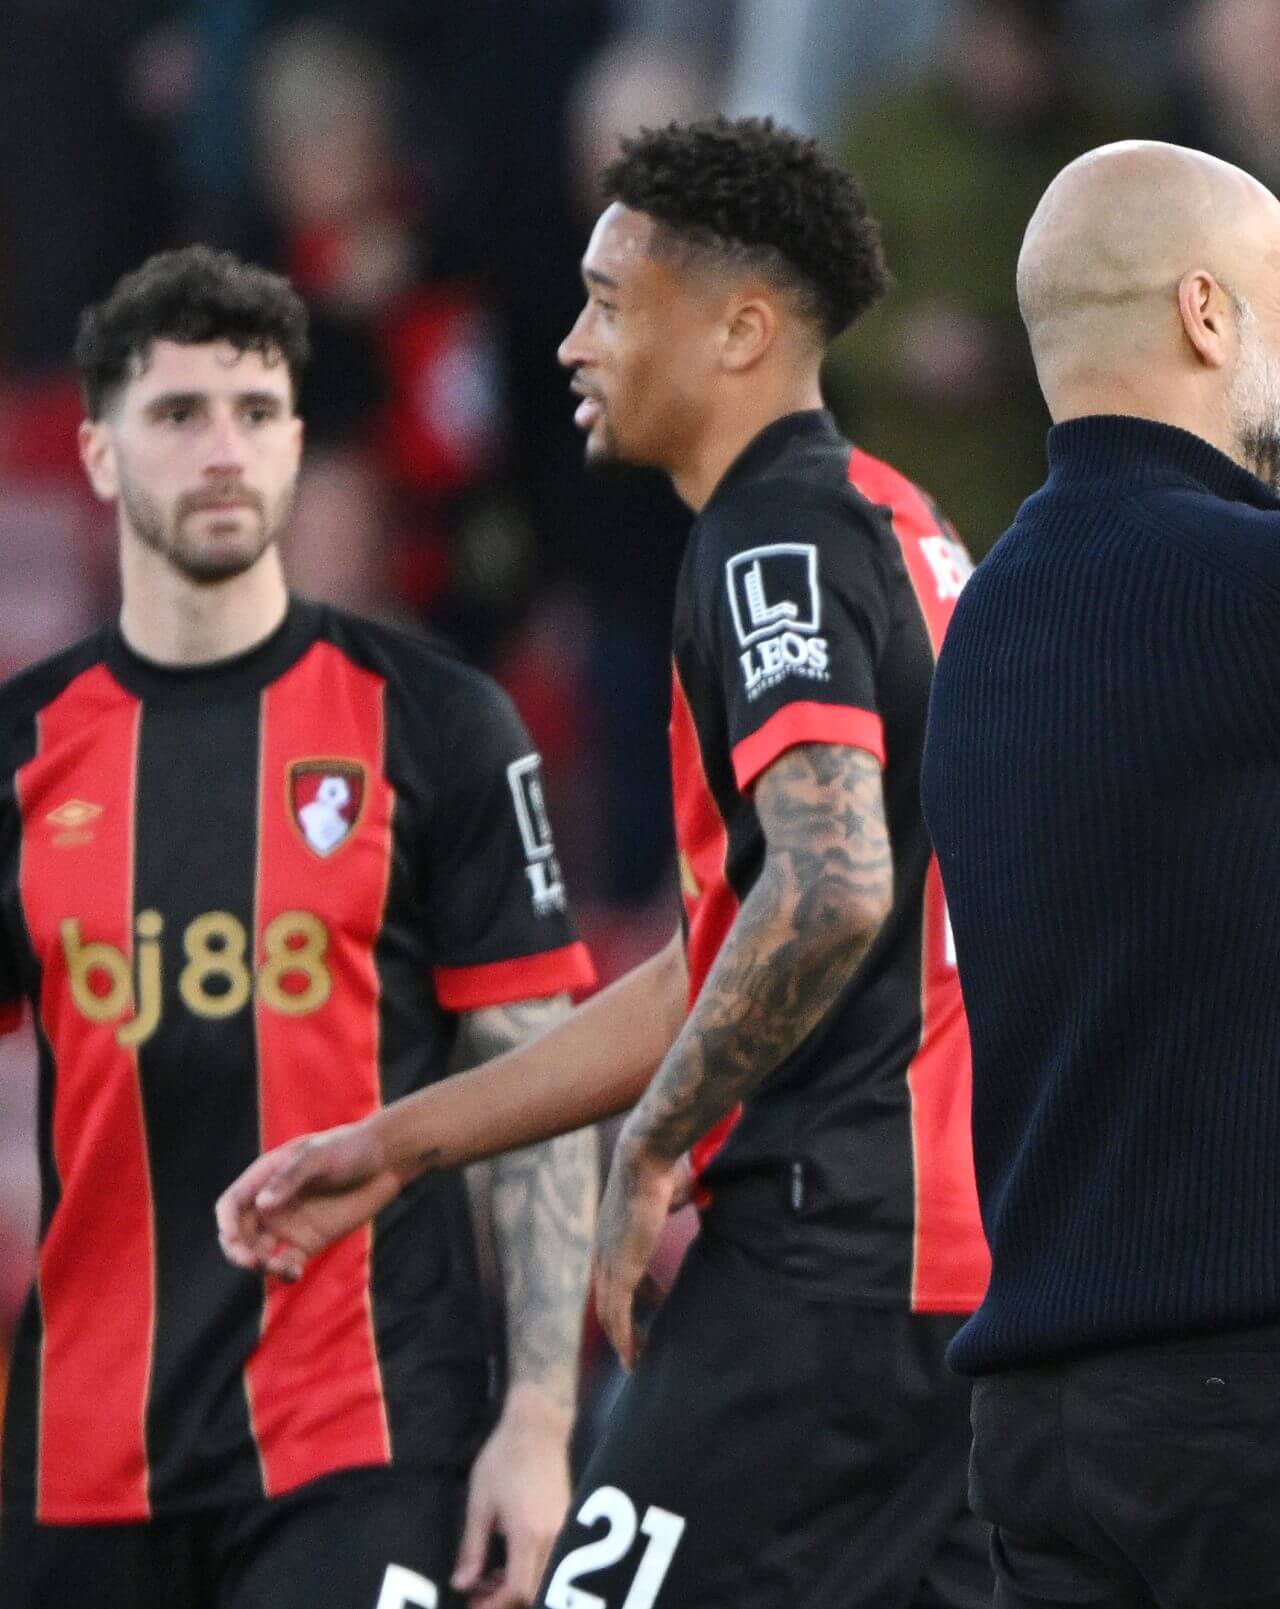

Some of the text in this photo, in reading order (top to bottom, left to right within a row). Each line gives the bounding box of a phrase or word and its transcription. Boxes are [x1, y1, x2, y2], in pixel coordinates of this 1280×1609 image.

[740, 632, 828, 690] LEOS
[60, 910, 332, 1047] bj88
[545, 1486, 686, 1609] 21
